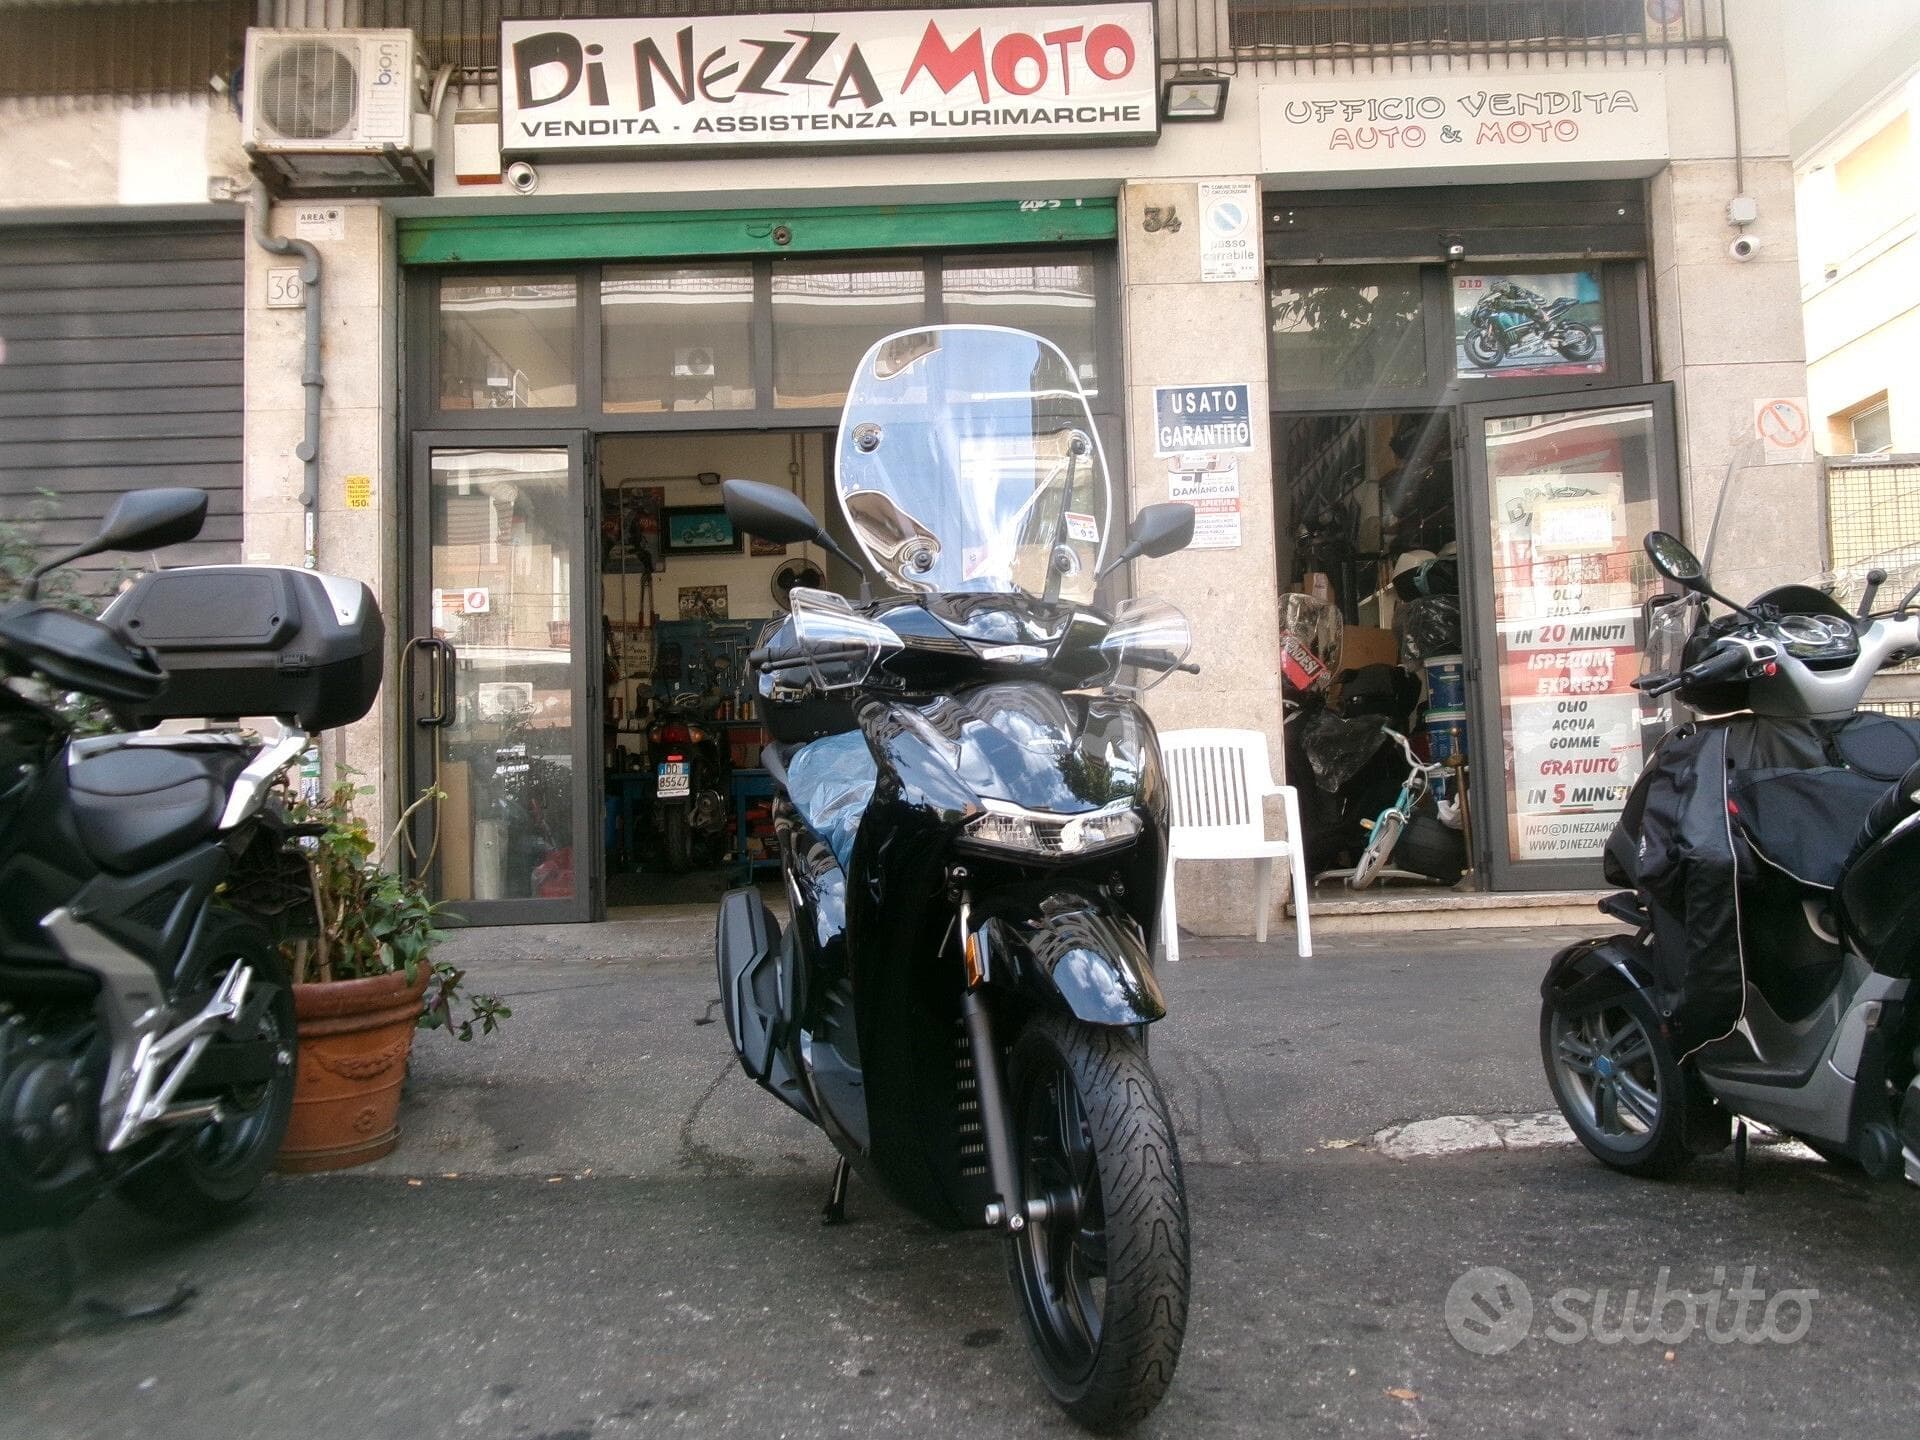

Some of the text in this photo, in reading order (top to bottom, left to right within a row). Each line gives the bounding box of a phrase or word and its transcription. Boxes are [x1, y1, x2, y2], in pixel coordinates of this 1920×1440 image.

[511, 31, 610, 111] Di
[900, 19, 1136, 104] MOTO
[1284, 90, 1639, 124] UFFICIO VENDITA
[520, 118, 661, 138] VENDITA
[692, 110, 898, 134] ASSISTENZA
[908, 105, 1141, 128] PLURIMARCHE
[1329, 119, 1580, 150] AUTO & MOTO
[300, 212, 325, 221] AREA
[1142, 203, 1182, 234] 34
[270, 275, 300, 300] 36
[1171, 390, 1237, 414] USATO
[1160, 421, 1250, 448] GARANTITO
[1515, 624, 1626, 644] IN 20 MINUTI
[1557, 700, 1588, 713] OLIO
[1552, 718, 1596, 732] ACQUA
[1549, 735, 1601, 749] GOMME
[1540, 757, 1619, 776] GRATUITO
[1527, 789, 1547, 805] IN
[1552, 783, 1567, 805] 5
